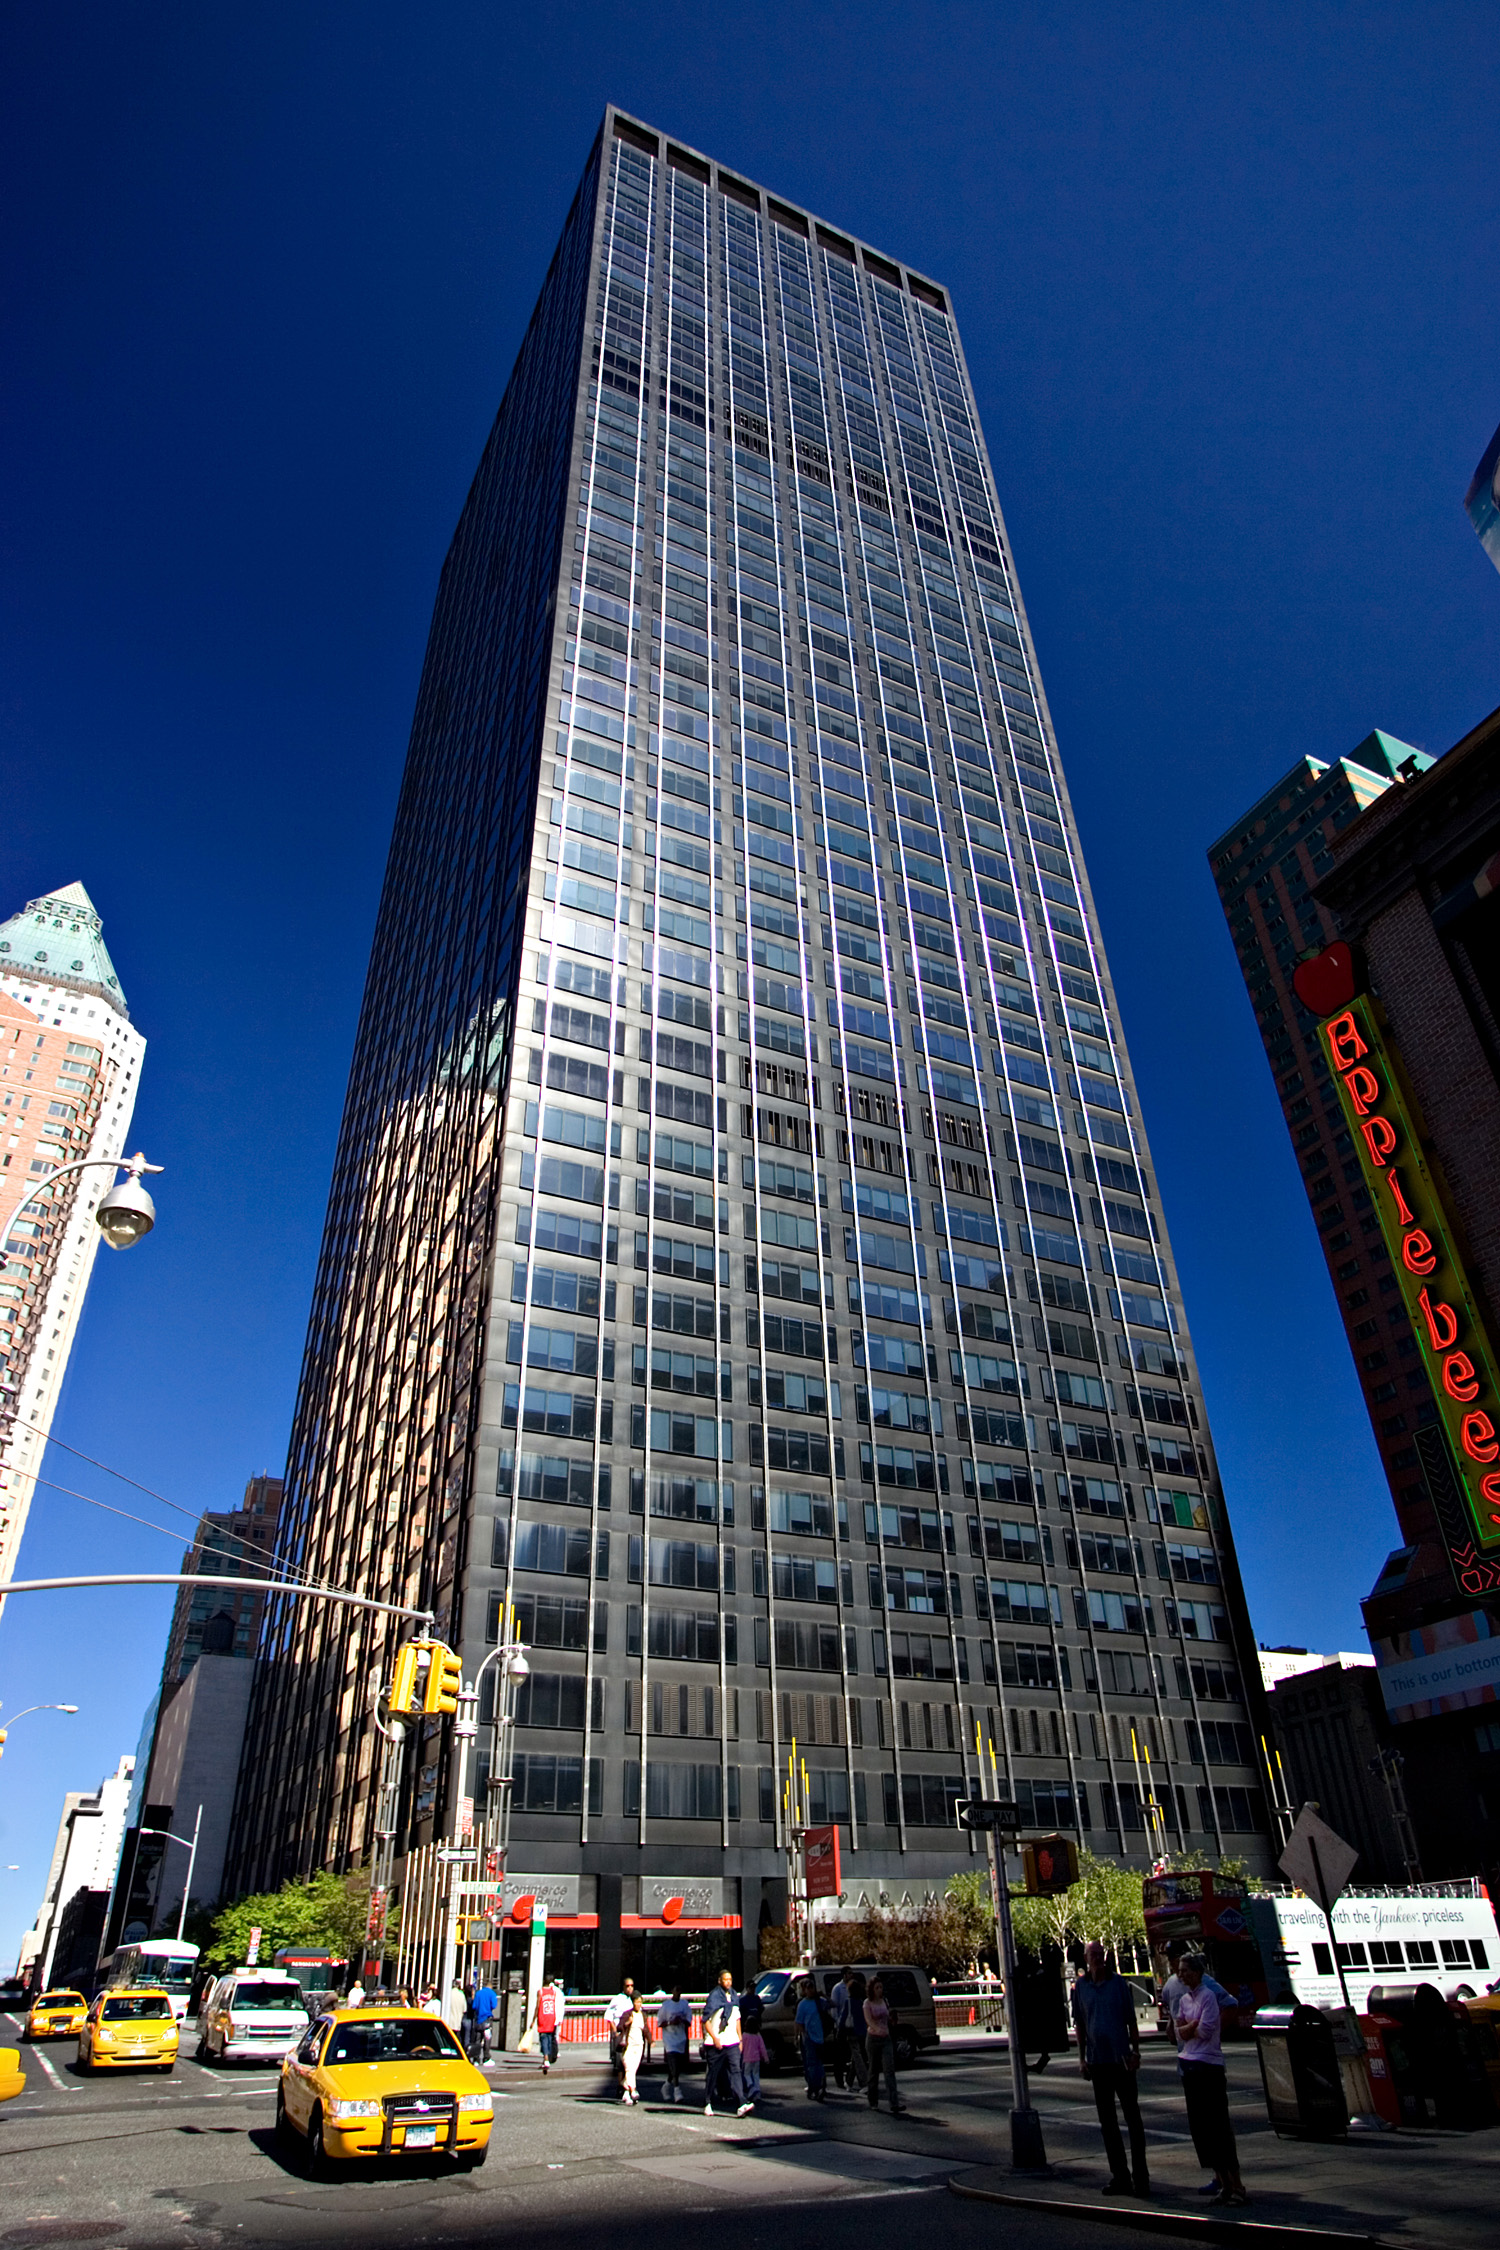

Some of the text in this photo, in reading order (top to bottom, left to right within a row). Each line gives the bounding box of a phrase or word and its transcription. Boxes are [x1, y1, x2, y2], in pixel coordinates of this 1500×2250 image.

[1326, 1010, 1500, 1526] Applebees
[1391, 1655, 1500, 1692] This is our bottom
[967, 1810, 1012, 1823] ONE WAY
[465, 1883, 498, 1893] BROADWAY
[504, 1882, 568, 1895] Commerce
[652, 1884, 713, 1897] Commerce
[535, 1896, 564, 1908] Bank
[684, 1897, 711, 1909] Bank
[1278, 1908, 1325, 1929] traveling
[1353, 1908, 1370, 1924] the
[1422, 1907, 1464, 1927] priceless
